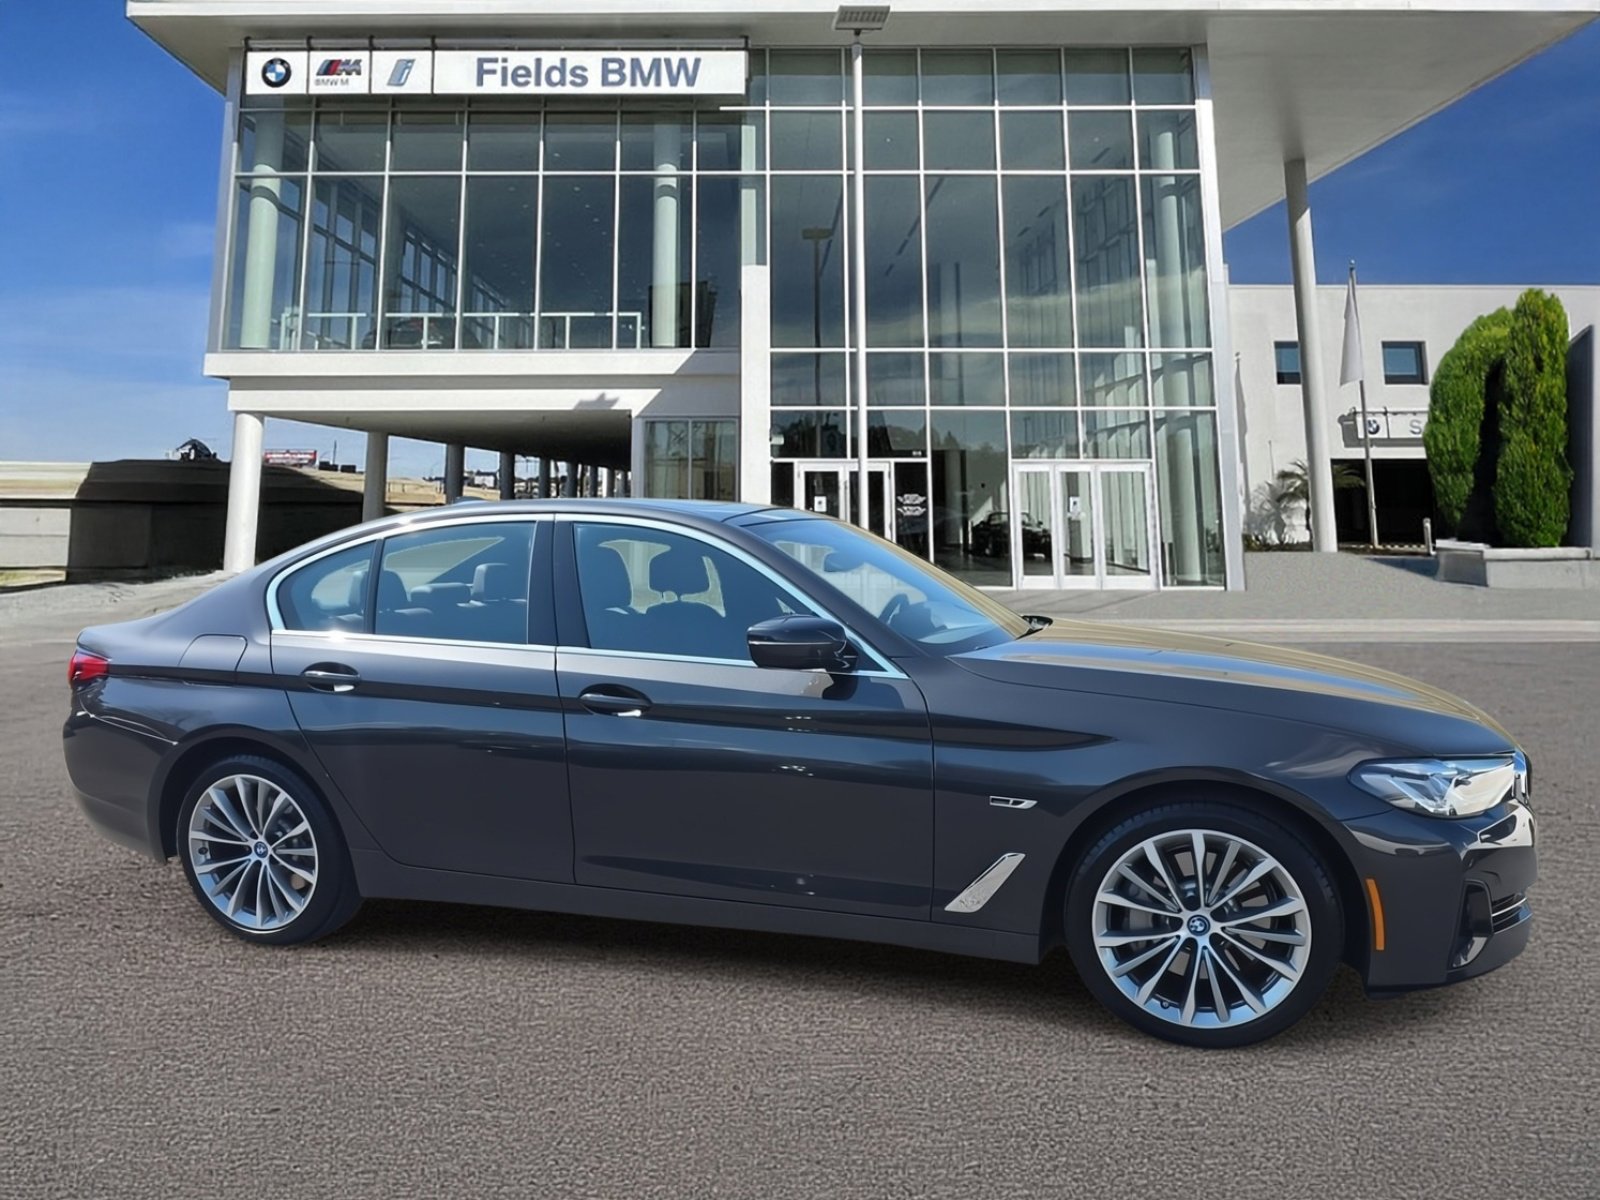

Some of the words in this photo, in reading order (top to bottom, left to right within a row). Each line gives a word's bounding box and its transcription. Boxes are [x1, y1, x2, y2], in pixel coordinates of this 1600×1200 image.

[476, 57, 589, 87] Fields
[601, 57, 702, 87] BMW
[314, 78, 339, 86] BMW
